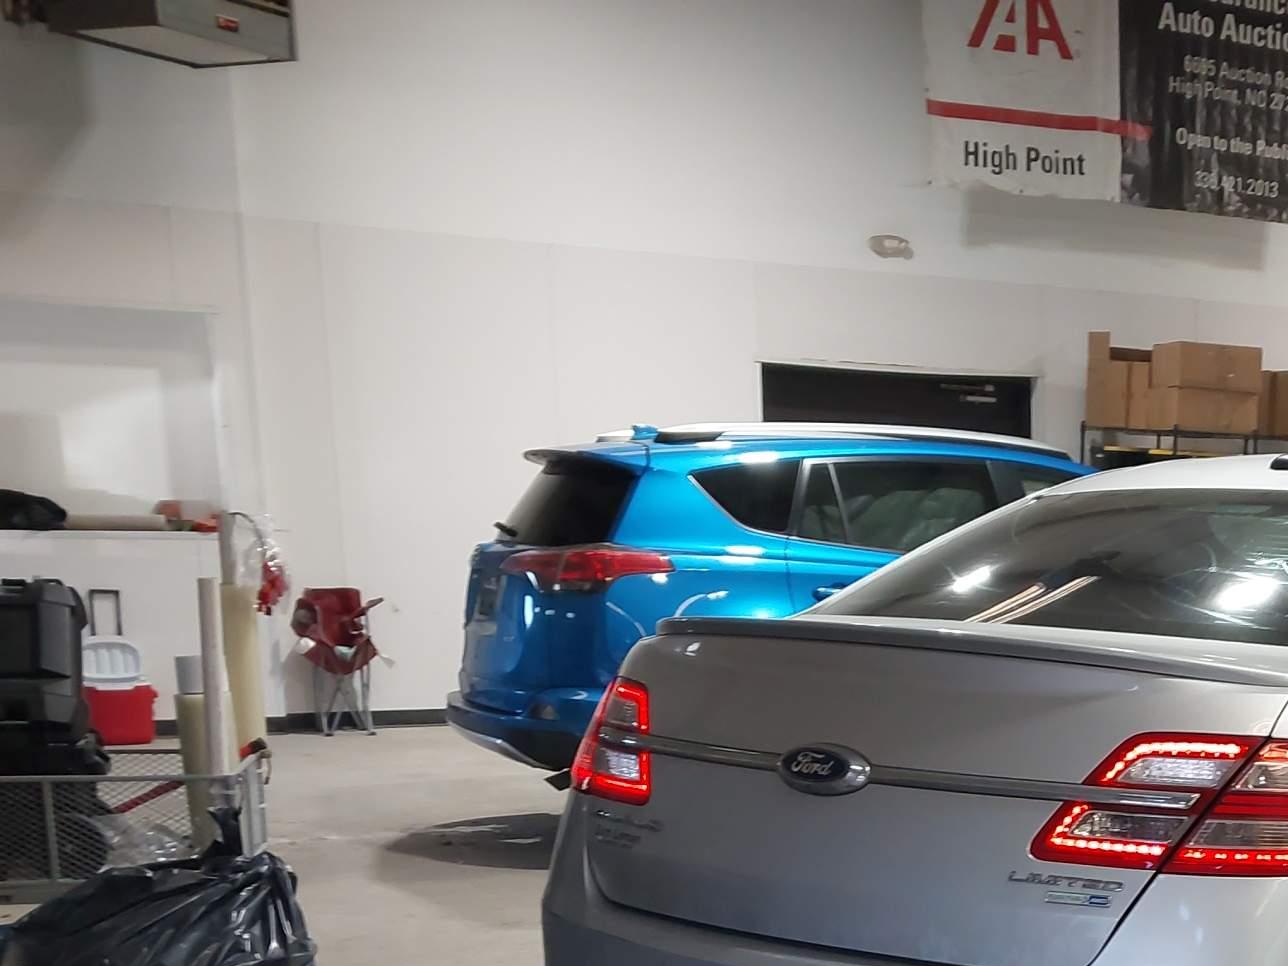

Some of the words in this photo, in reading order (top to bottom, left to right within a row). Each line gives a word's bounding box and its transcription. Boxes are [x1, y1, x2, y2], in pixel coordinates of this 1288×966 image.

[1157, 1, 1215, 38] Auto
[1219, 61, 1272, 87] Auction
[1168, 75, 1202, 99] High
[1245, 88, 1267, 108] NC
[1175, 127, 1211, 150] Open
[1213, 135, 1228, 151] to
[1230, 136, 1253, 156] the
[963, 140, 1018, 175] High
[1025, 146, 1086, 176] Point
[790, 750, 834, 777] Ford
